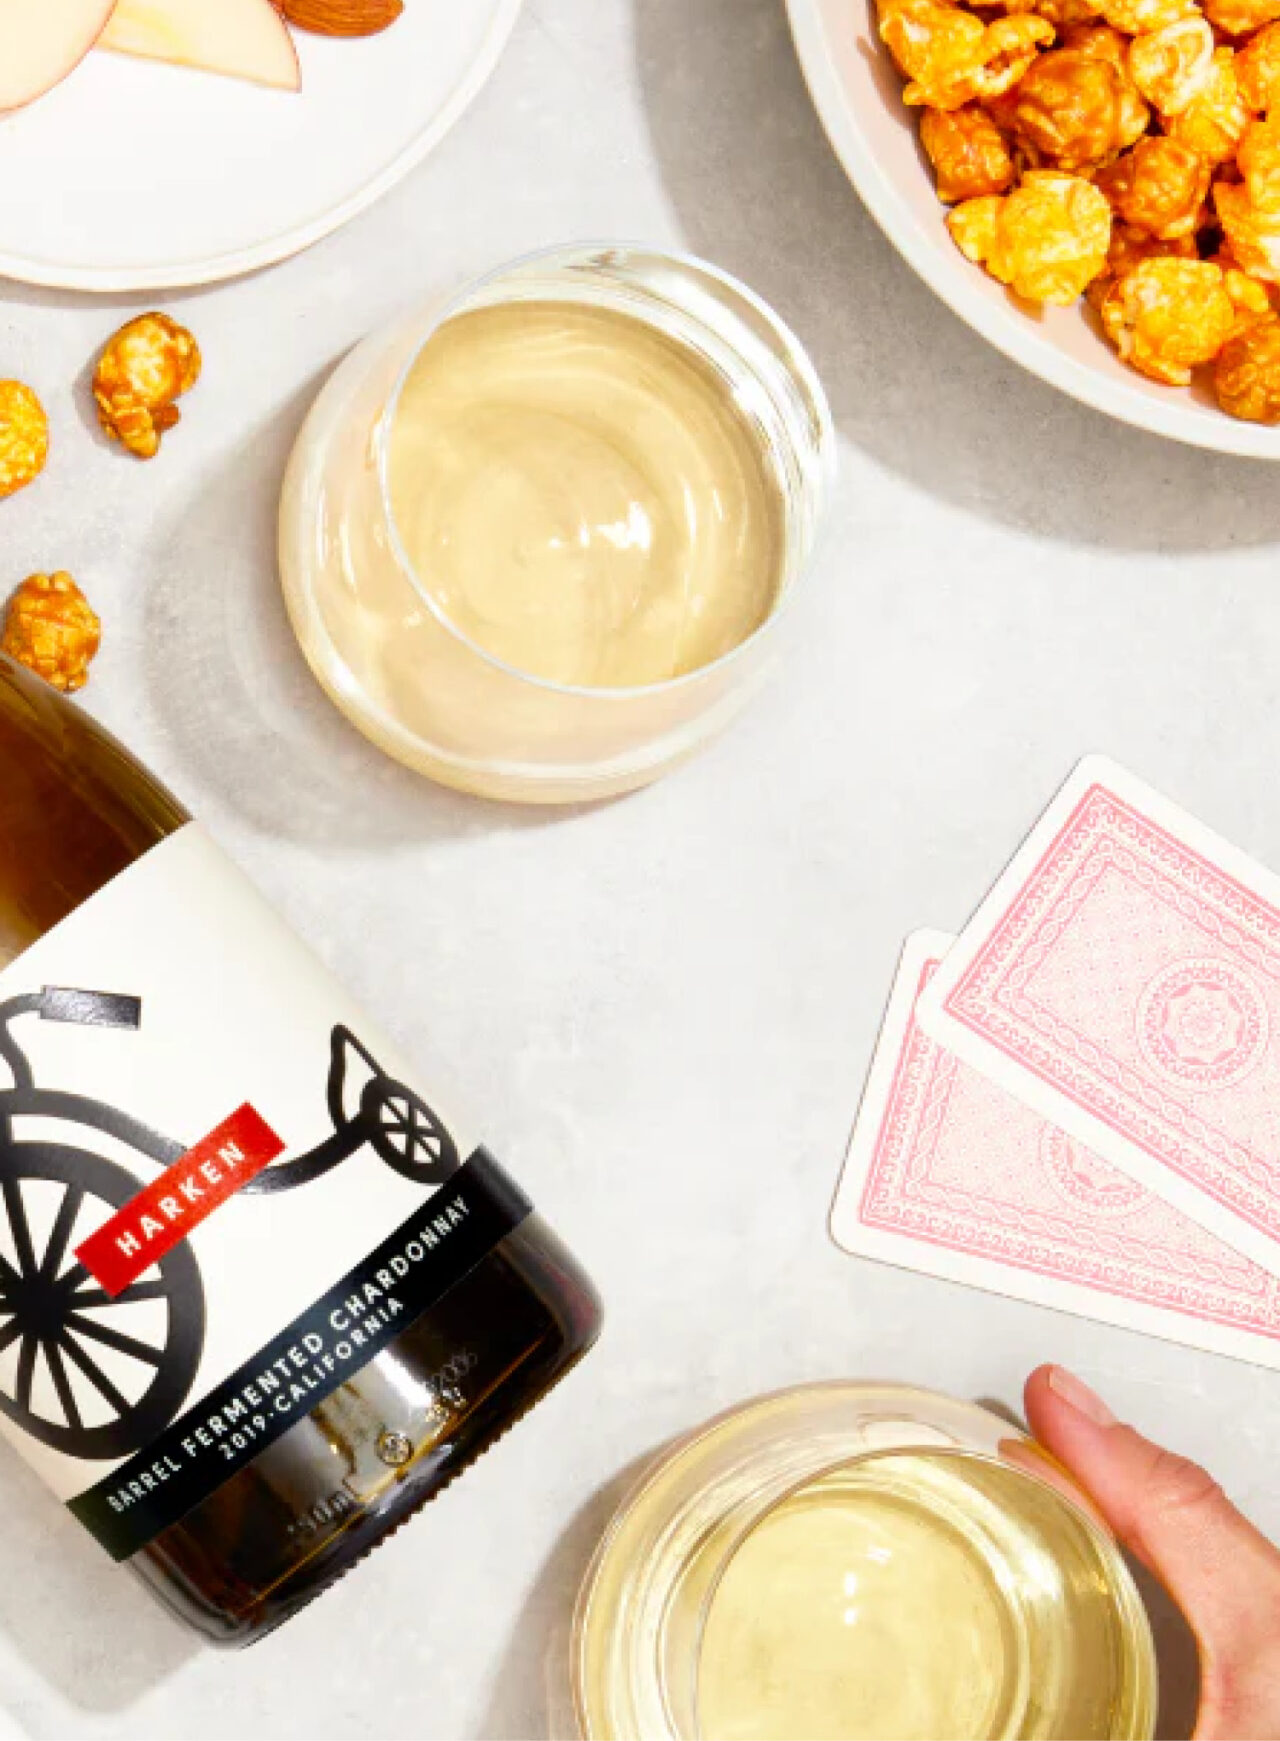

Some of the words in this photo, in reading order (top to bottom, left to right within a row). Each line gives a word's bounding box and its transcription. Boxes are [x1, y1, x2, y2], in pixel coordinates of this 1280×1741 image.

[114, 1139, 246, 1258] HARKEN
[106, 1456, 182, 1512] BARREL
[181, 1332, 323, 1457] FERMENTED
[329, 1195, 469, 1330] CHARDONNAY
